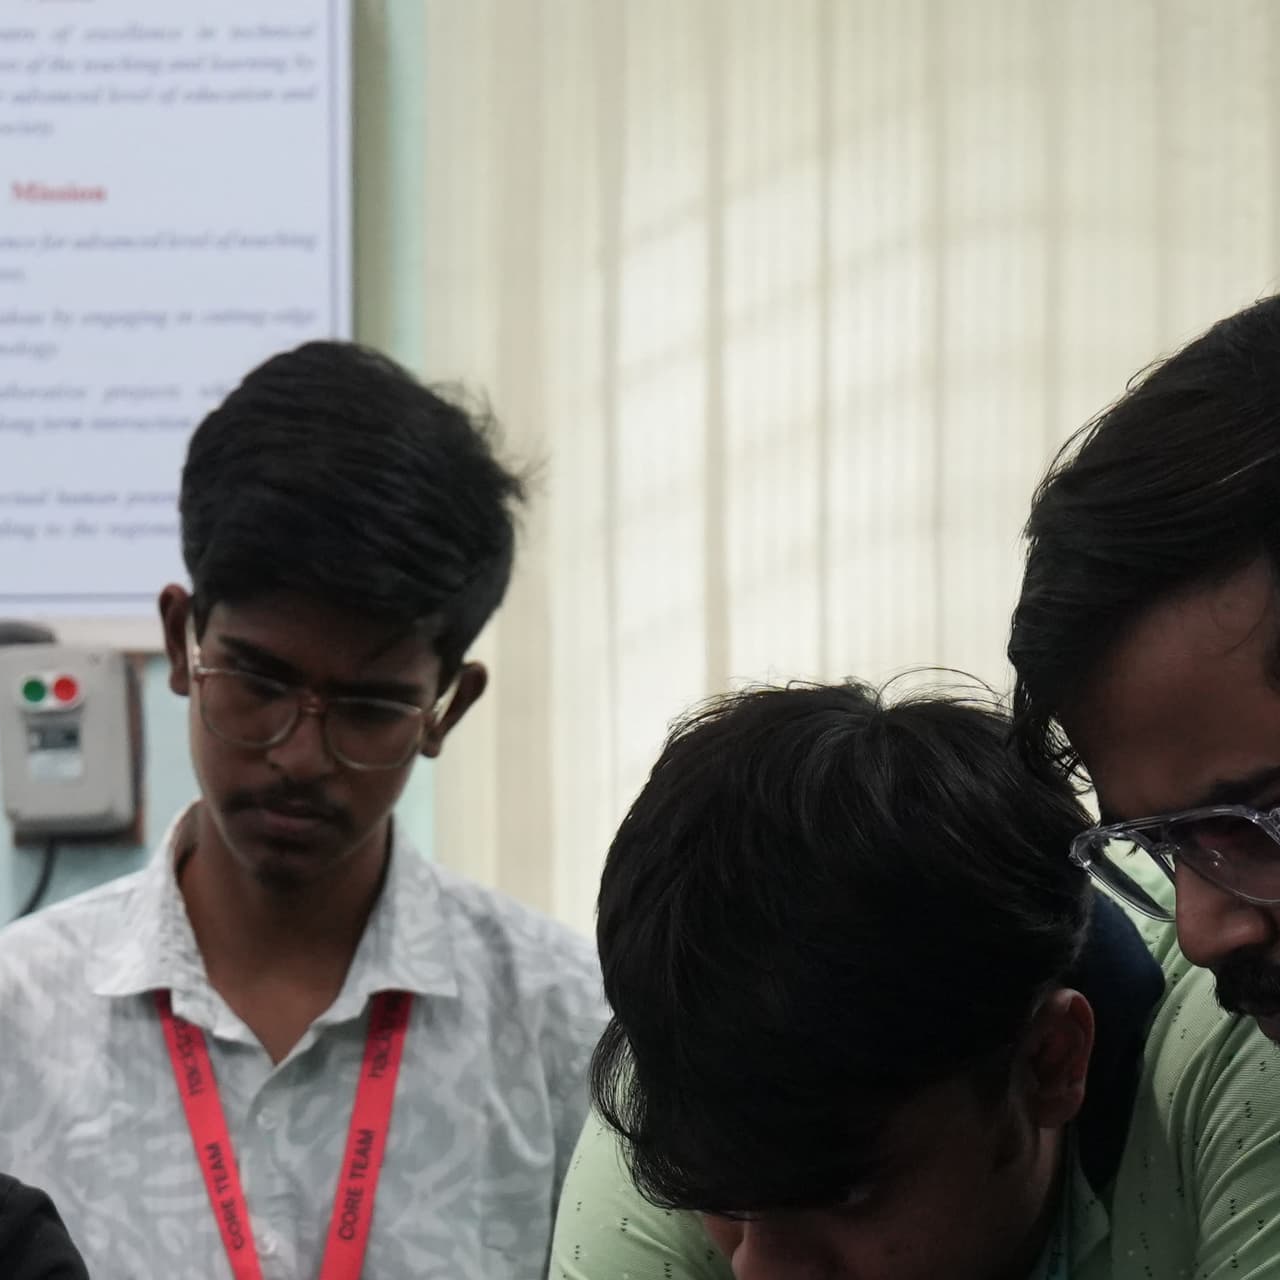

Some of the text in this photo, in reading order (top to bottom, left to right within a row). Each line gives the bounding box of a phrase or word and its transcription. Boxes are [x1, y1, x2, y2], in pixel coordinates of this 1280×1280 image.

[10, 180, 106, 204] Mission
[206, 1141, 245, 1251] CORE TEAM
[338, 1128, 376, 1241] CORE TEAM
